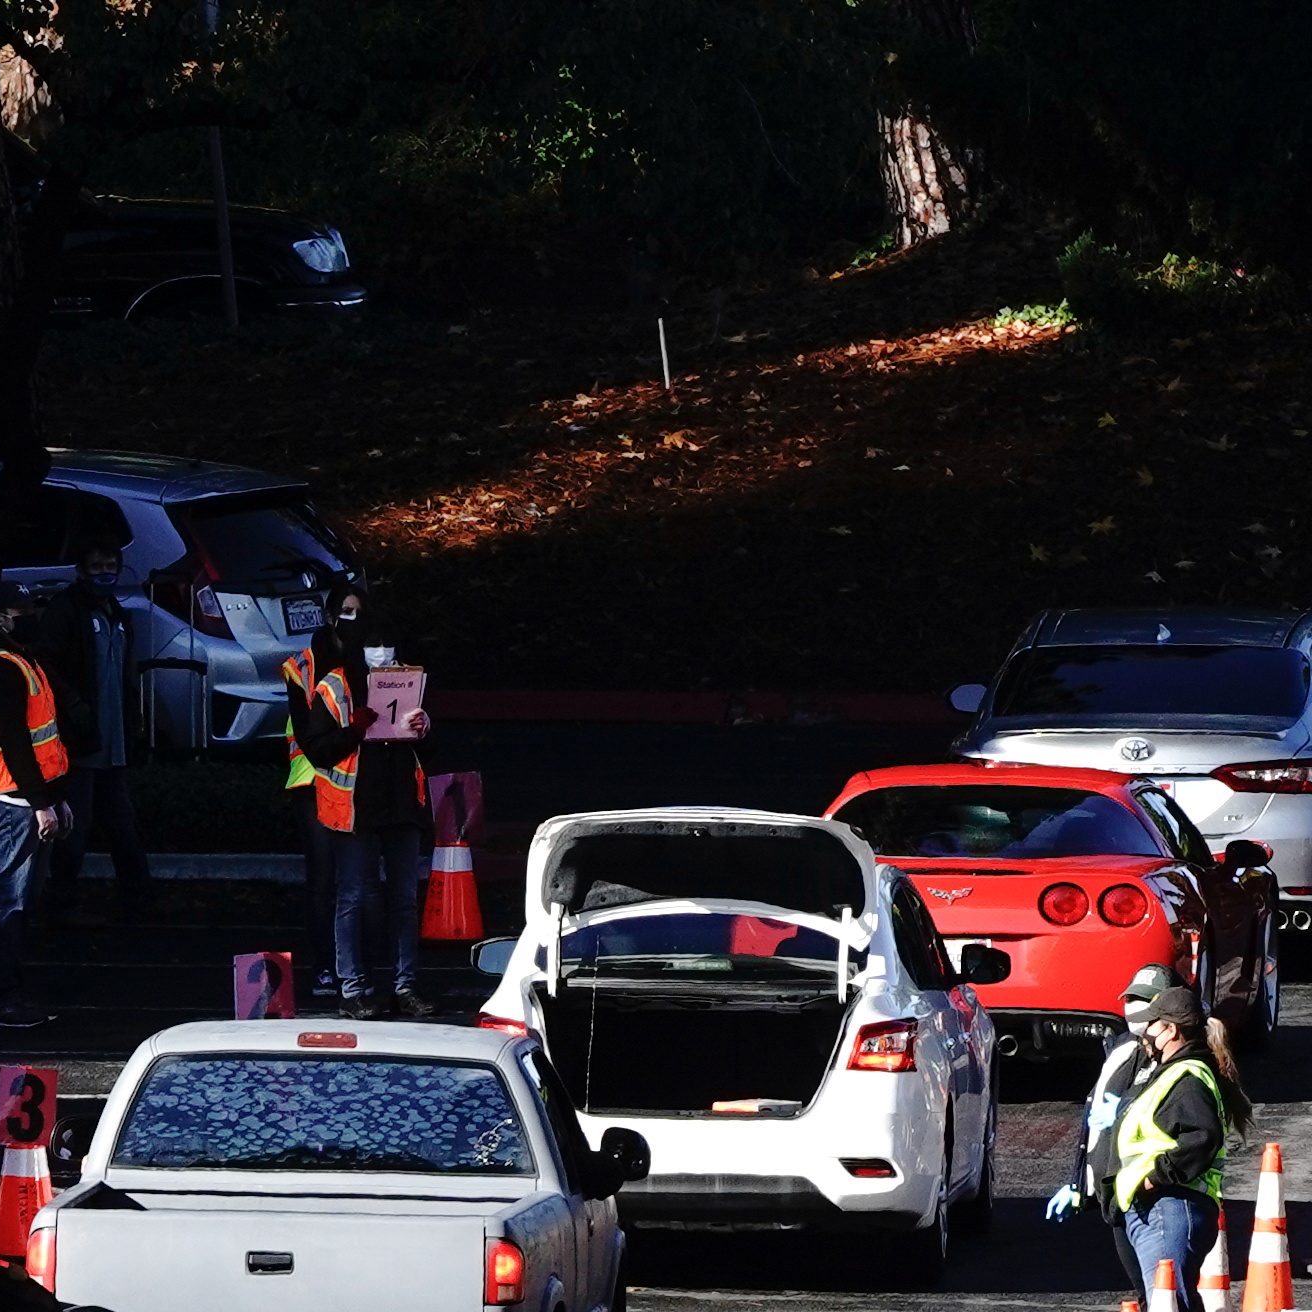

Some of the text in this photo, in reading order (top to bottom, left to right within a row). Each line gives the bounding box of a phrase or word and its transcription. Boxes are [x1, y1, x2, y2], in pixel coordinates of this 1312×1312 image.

[376, 680, 414, 689] Station #
[386, 698, 399, 725] 1
[247, 959, 283, 1019] 2
[7, 1073, 46, 1143] 3
